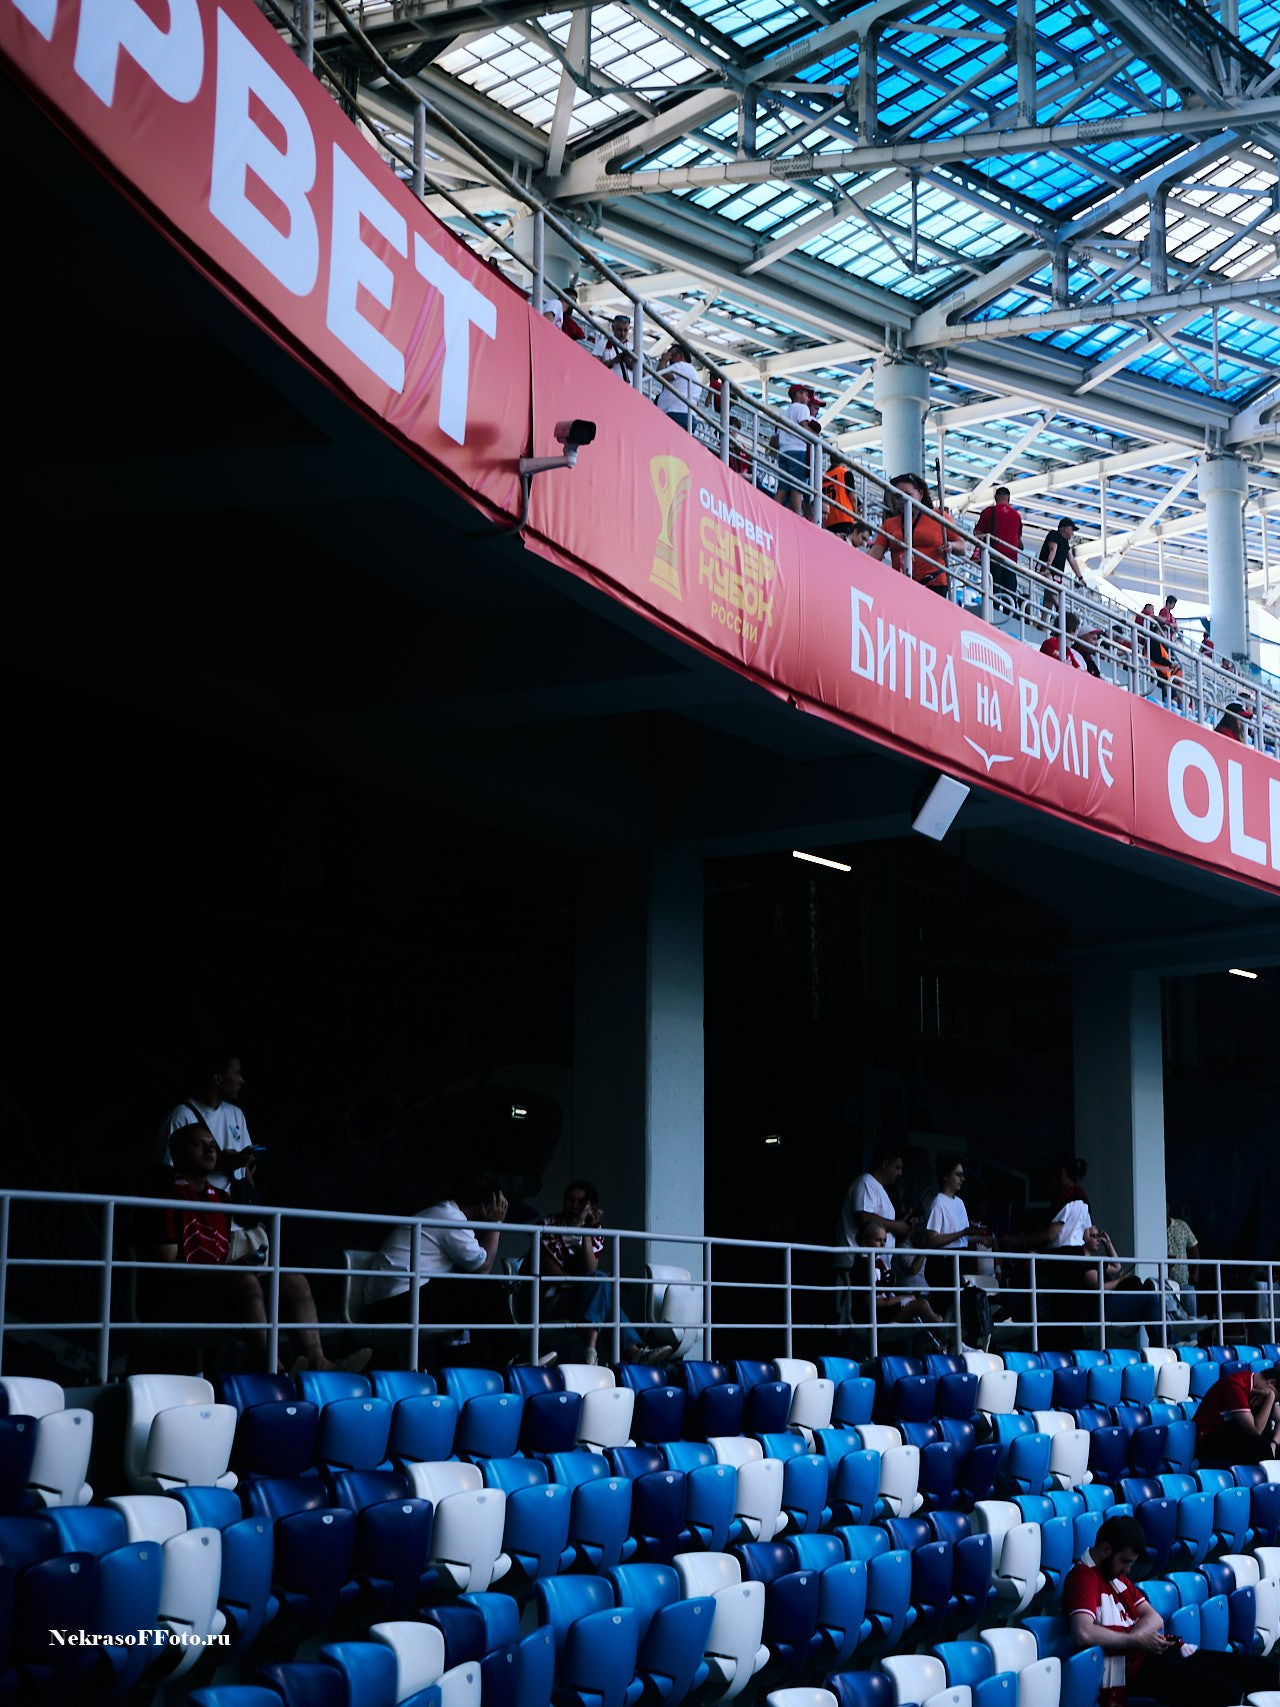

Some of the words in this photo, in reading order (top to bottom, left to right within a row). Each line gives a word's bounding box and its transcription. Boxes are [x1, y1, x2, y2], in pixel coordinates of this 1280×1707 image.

[699, 487, 773, 551] OLIMPBET
[700, 515, 775, 582] СУПЕР
[699, 549, 774, 628] КУБОК
[711, 600, 758, 645] РОССИИ
